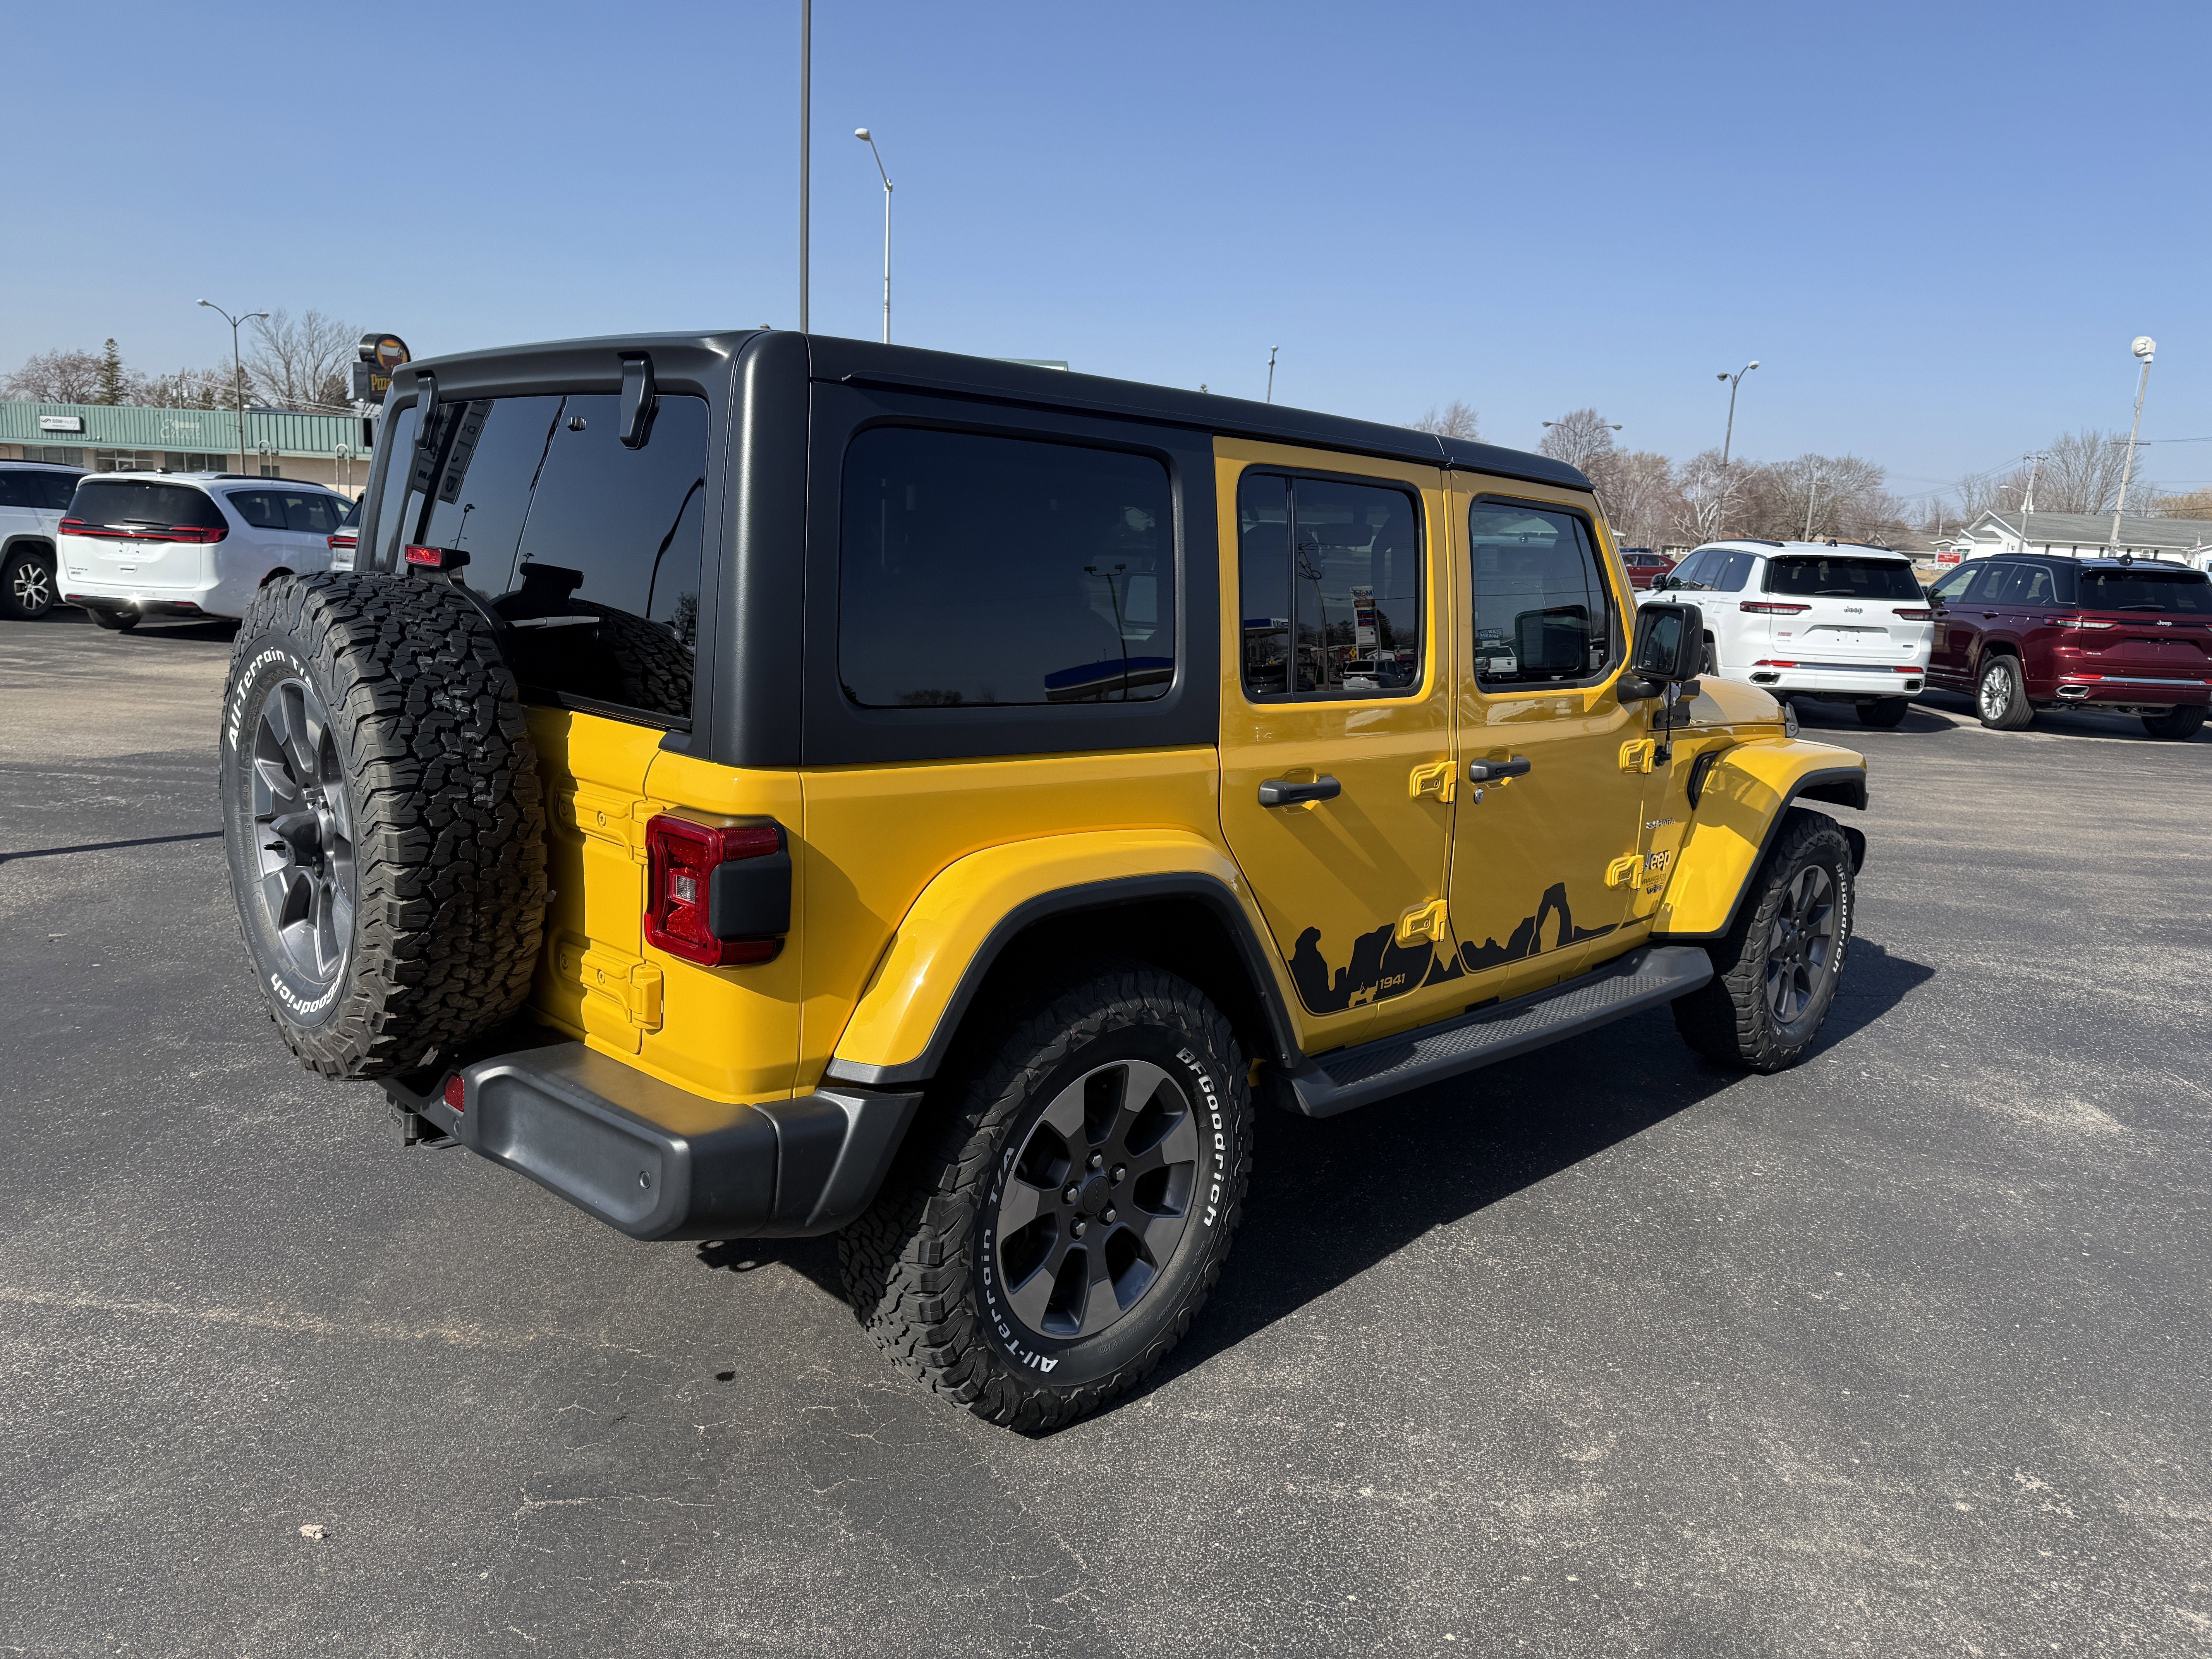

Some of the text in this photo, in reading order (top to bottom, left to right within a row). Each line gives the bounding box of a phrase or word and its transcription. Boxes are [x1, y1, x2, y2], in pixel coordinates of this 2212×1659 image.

[229, 647, 285, 752] All-Terrain
[1644, 849, 1671, 871] Jeep
[1646, 817, 1676, 829] SAHARA
[1833, 862, 1847, 973] BFGoodrich
[271, 948, 347, 1015] BFGoodrich
[1380, 973, 1405, 989] 1941
[1176, 1048, 1226, 1227] BFGoodrich
[981, 1229, 1058, 1373] All-Terrain
